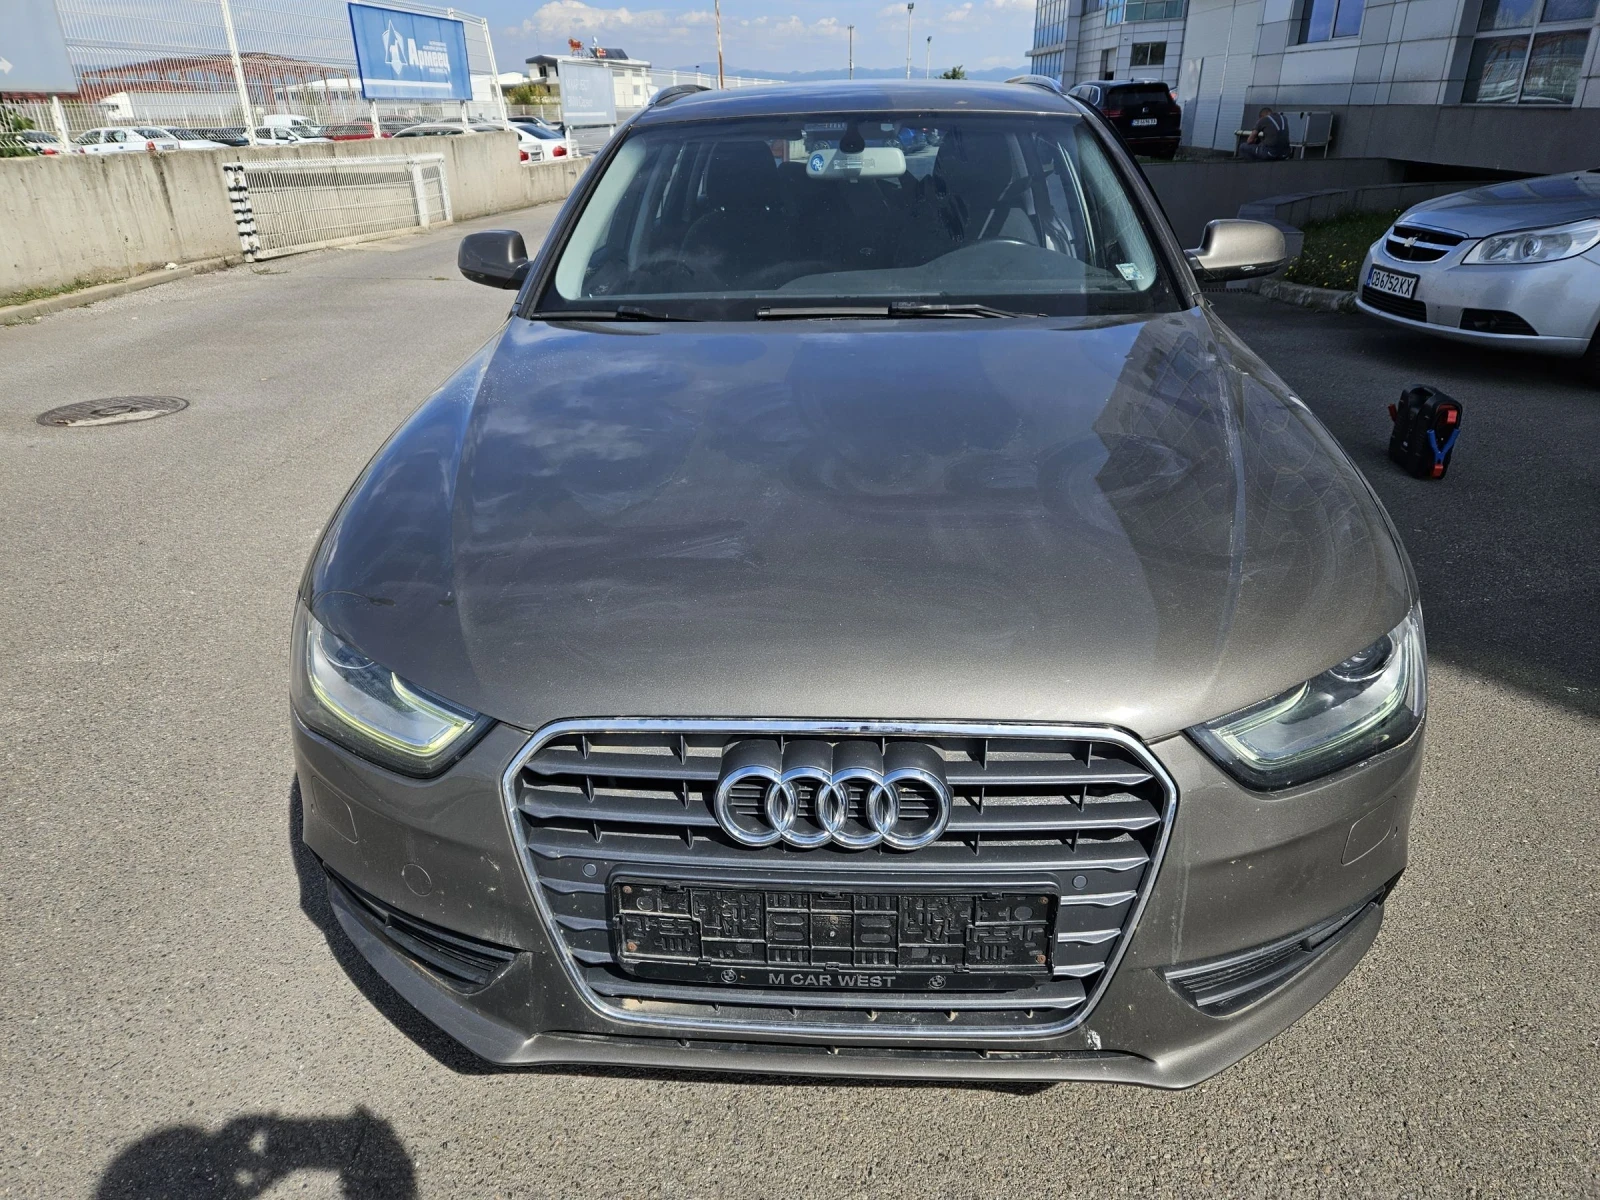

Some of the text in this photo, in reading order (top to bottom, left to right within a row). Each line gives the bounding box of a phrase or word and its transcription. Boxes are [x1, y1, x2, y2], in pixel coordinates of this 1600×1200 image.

[768, 973, 896, 987] M CAR WEST
